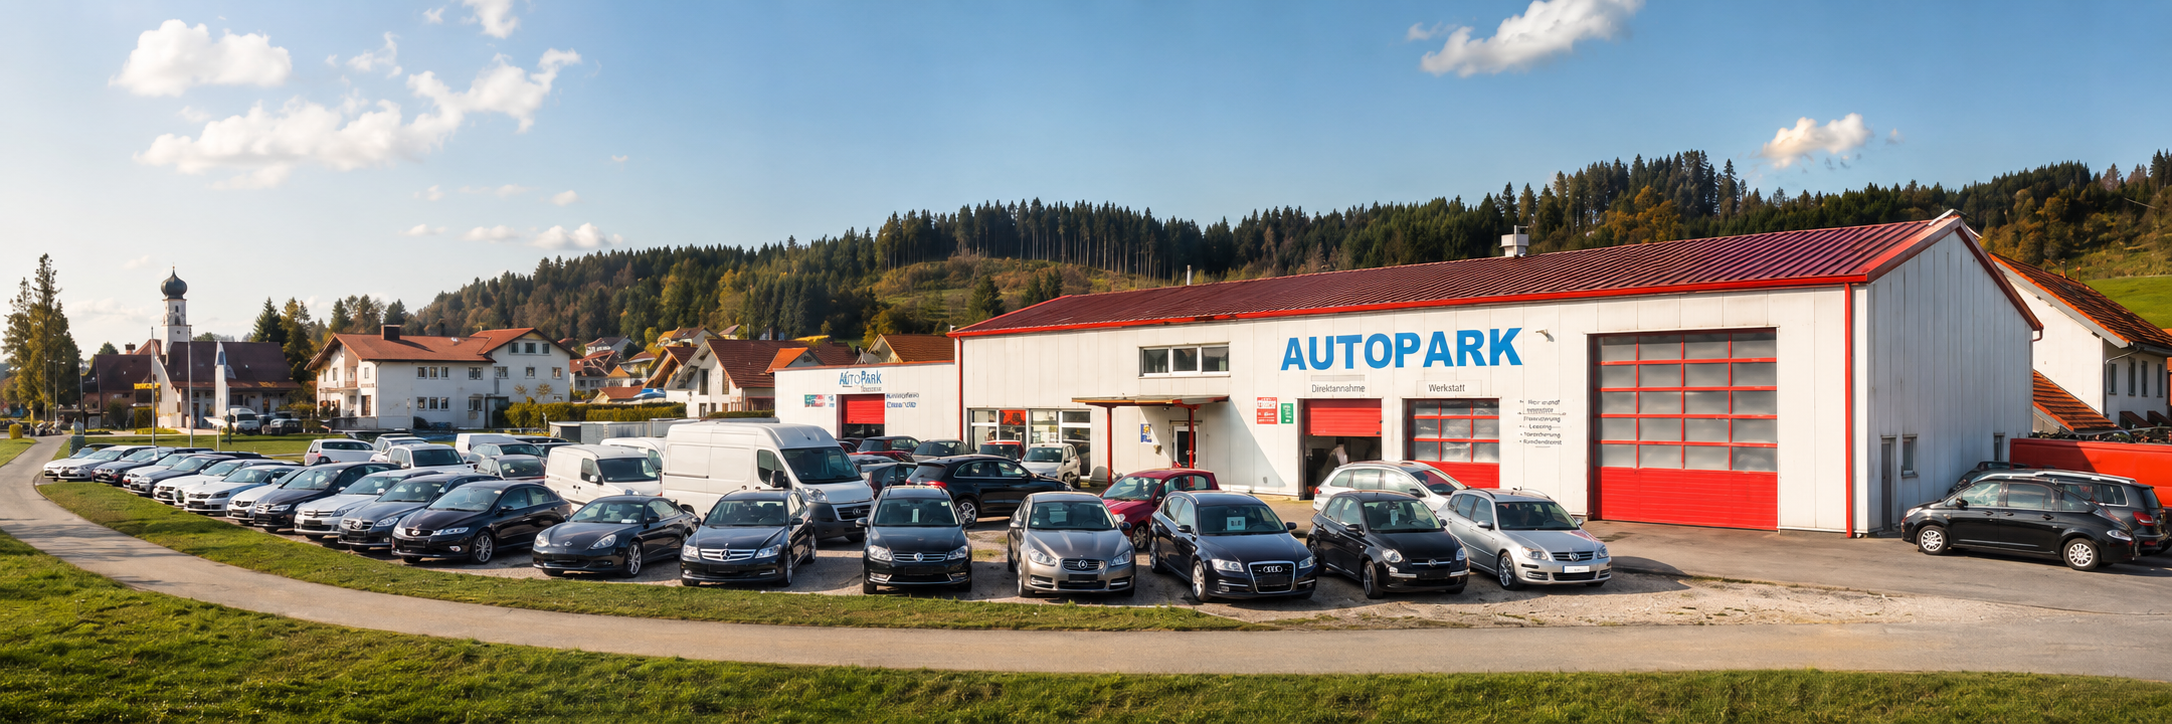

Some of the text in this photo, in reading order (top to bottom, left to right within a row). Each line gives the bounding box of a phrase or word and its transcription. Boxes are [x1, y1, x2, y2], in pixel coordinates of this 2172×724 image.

[1280, 327, 1523, 371] AUTOPARK
[1311, 384, 1366, 393] Direktannahme
[1428, 384, 1466, 393] Werkstatt
